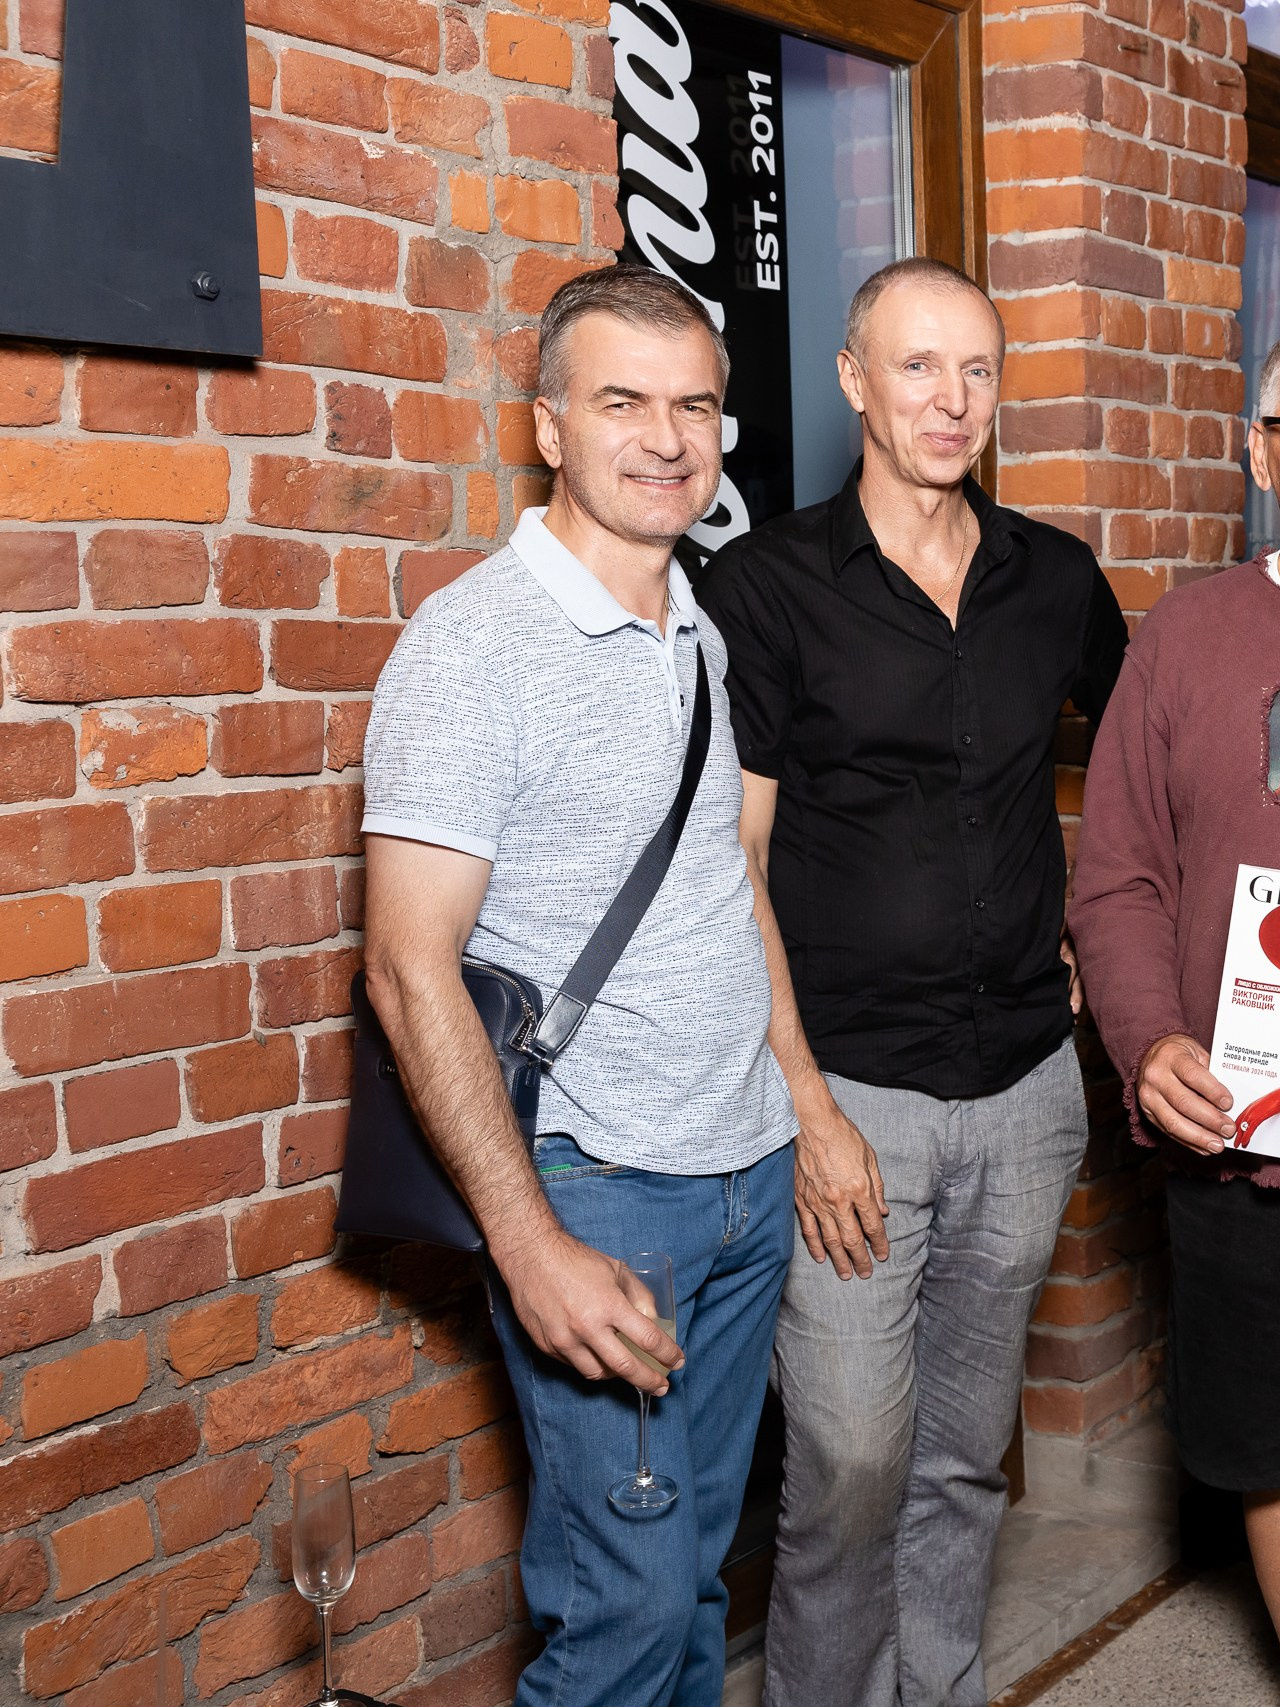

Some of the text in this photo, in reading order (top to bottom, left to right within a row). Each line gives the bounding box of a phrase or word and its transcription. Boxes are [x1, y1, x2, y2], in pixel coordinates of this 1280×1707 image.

[747, 70, 781, 291] EST. 2011
[1233, 989, 1273, 1002] ВИКТОРИЯ
[1231, 997, 1275, 1011] РАКОВЩИК
[1224, 1042, 1278, 1059] Загородные дома
[1223, 1052, 1241, 1061] снова
[1248, 1056, 1269, 1066] тренде
[1222, 1062, 1278, 1078] ФЕСТИВАЛИ 2024 ГОДА
